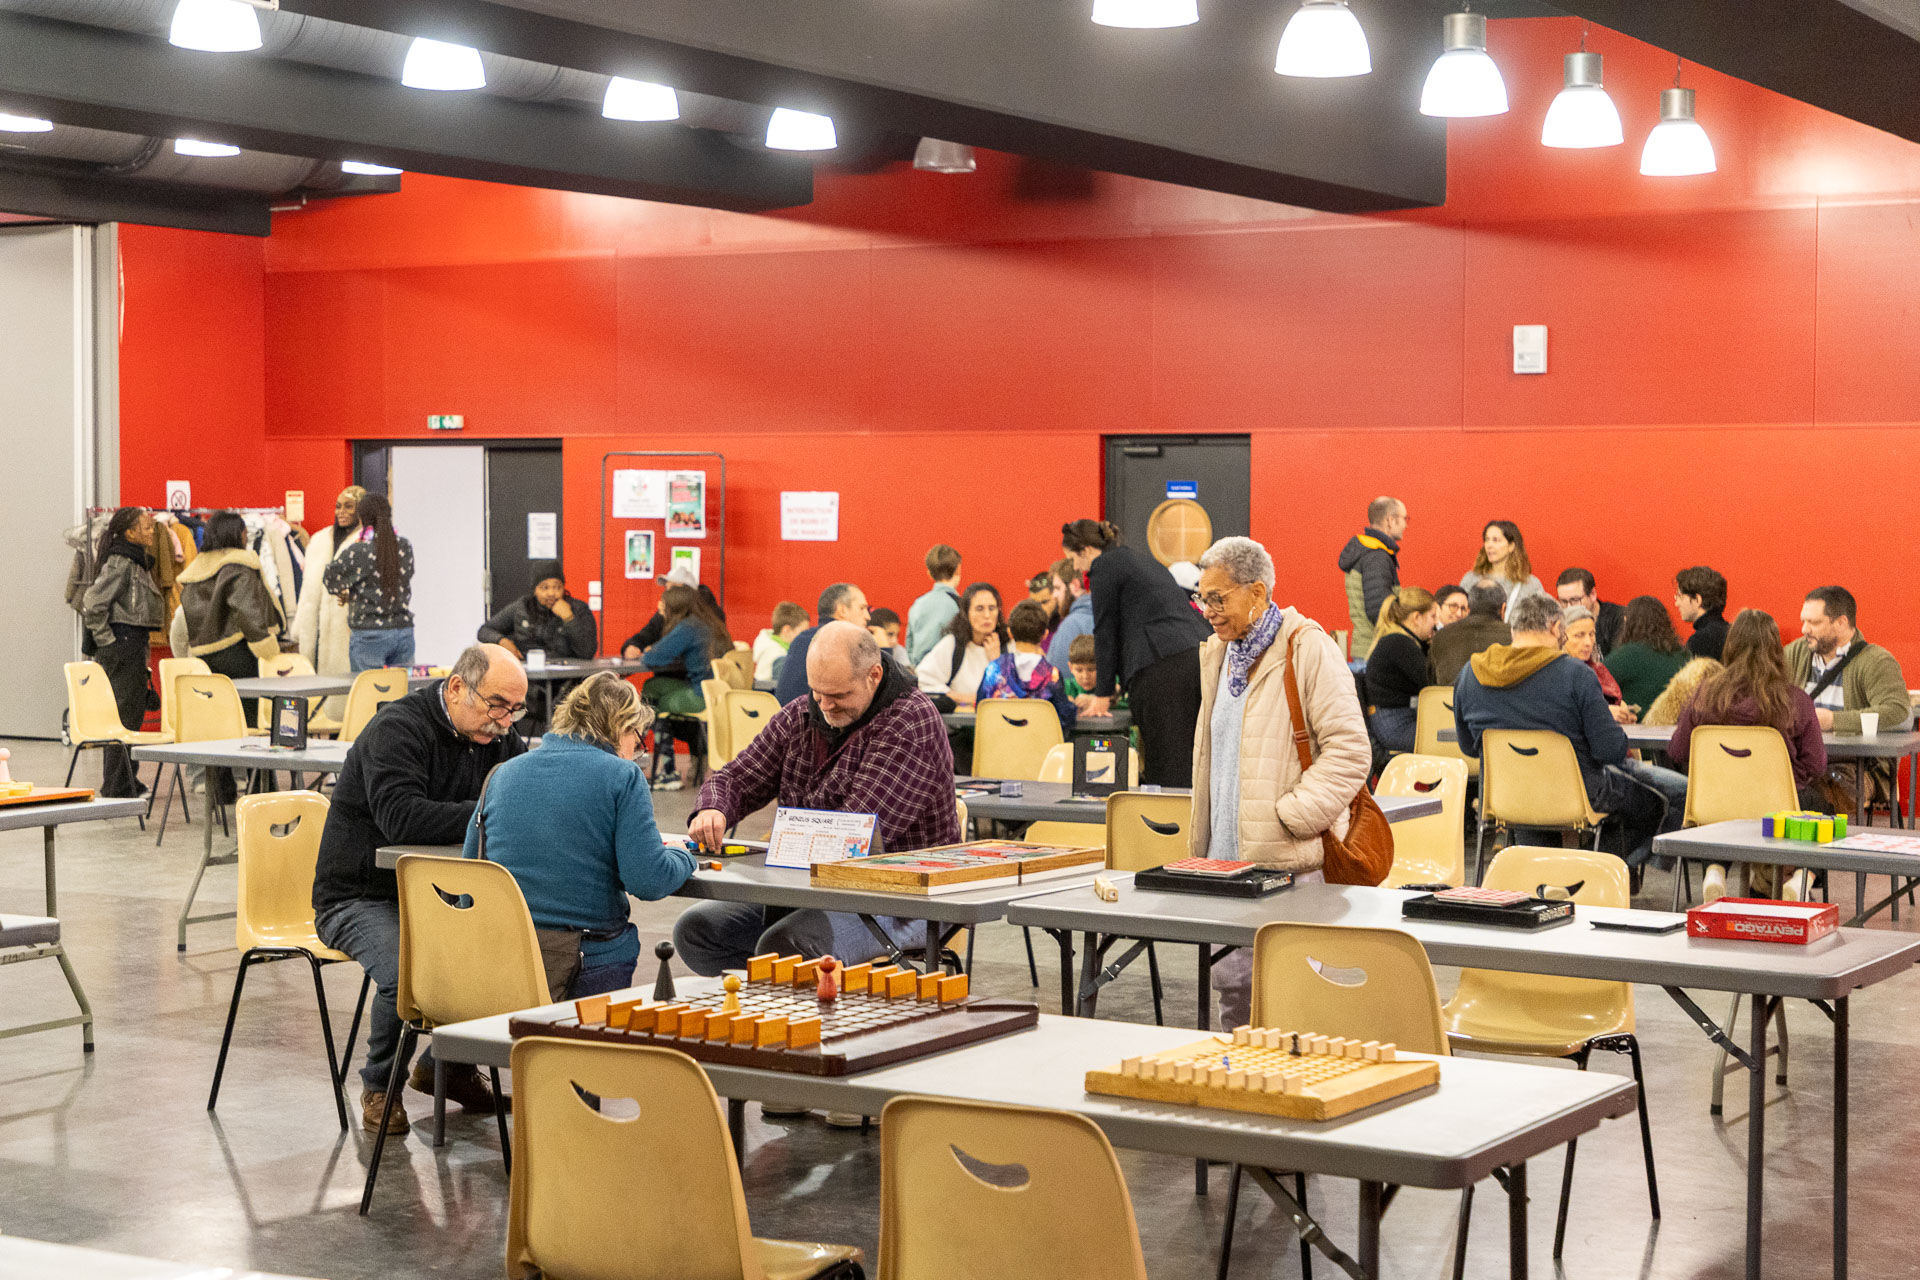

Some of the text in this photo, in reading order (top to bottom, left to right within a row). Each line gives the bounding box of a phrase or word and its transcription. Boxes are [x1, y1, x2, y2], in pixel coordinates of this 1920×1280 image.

[788, 815, 810, 823] GENIUS
[811, 817, 834, 825] SQUARE
[1734, 922, 1804, 936] PENTAGO
